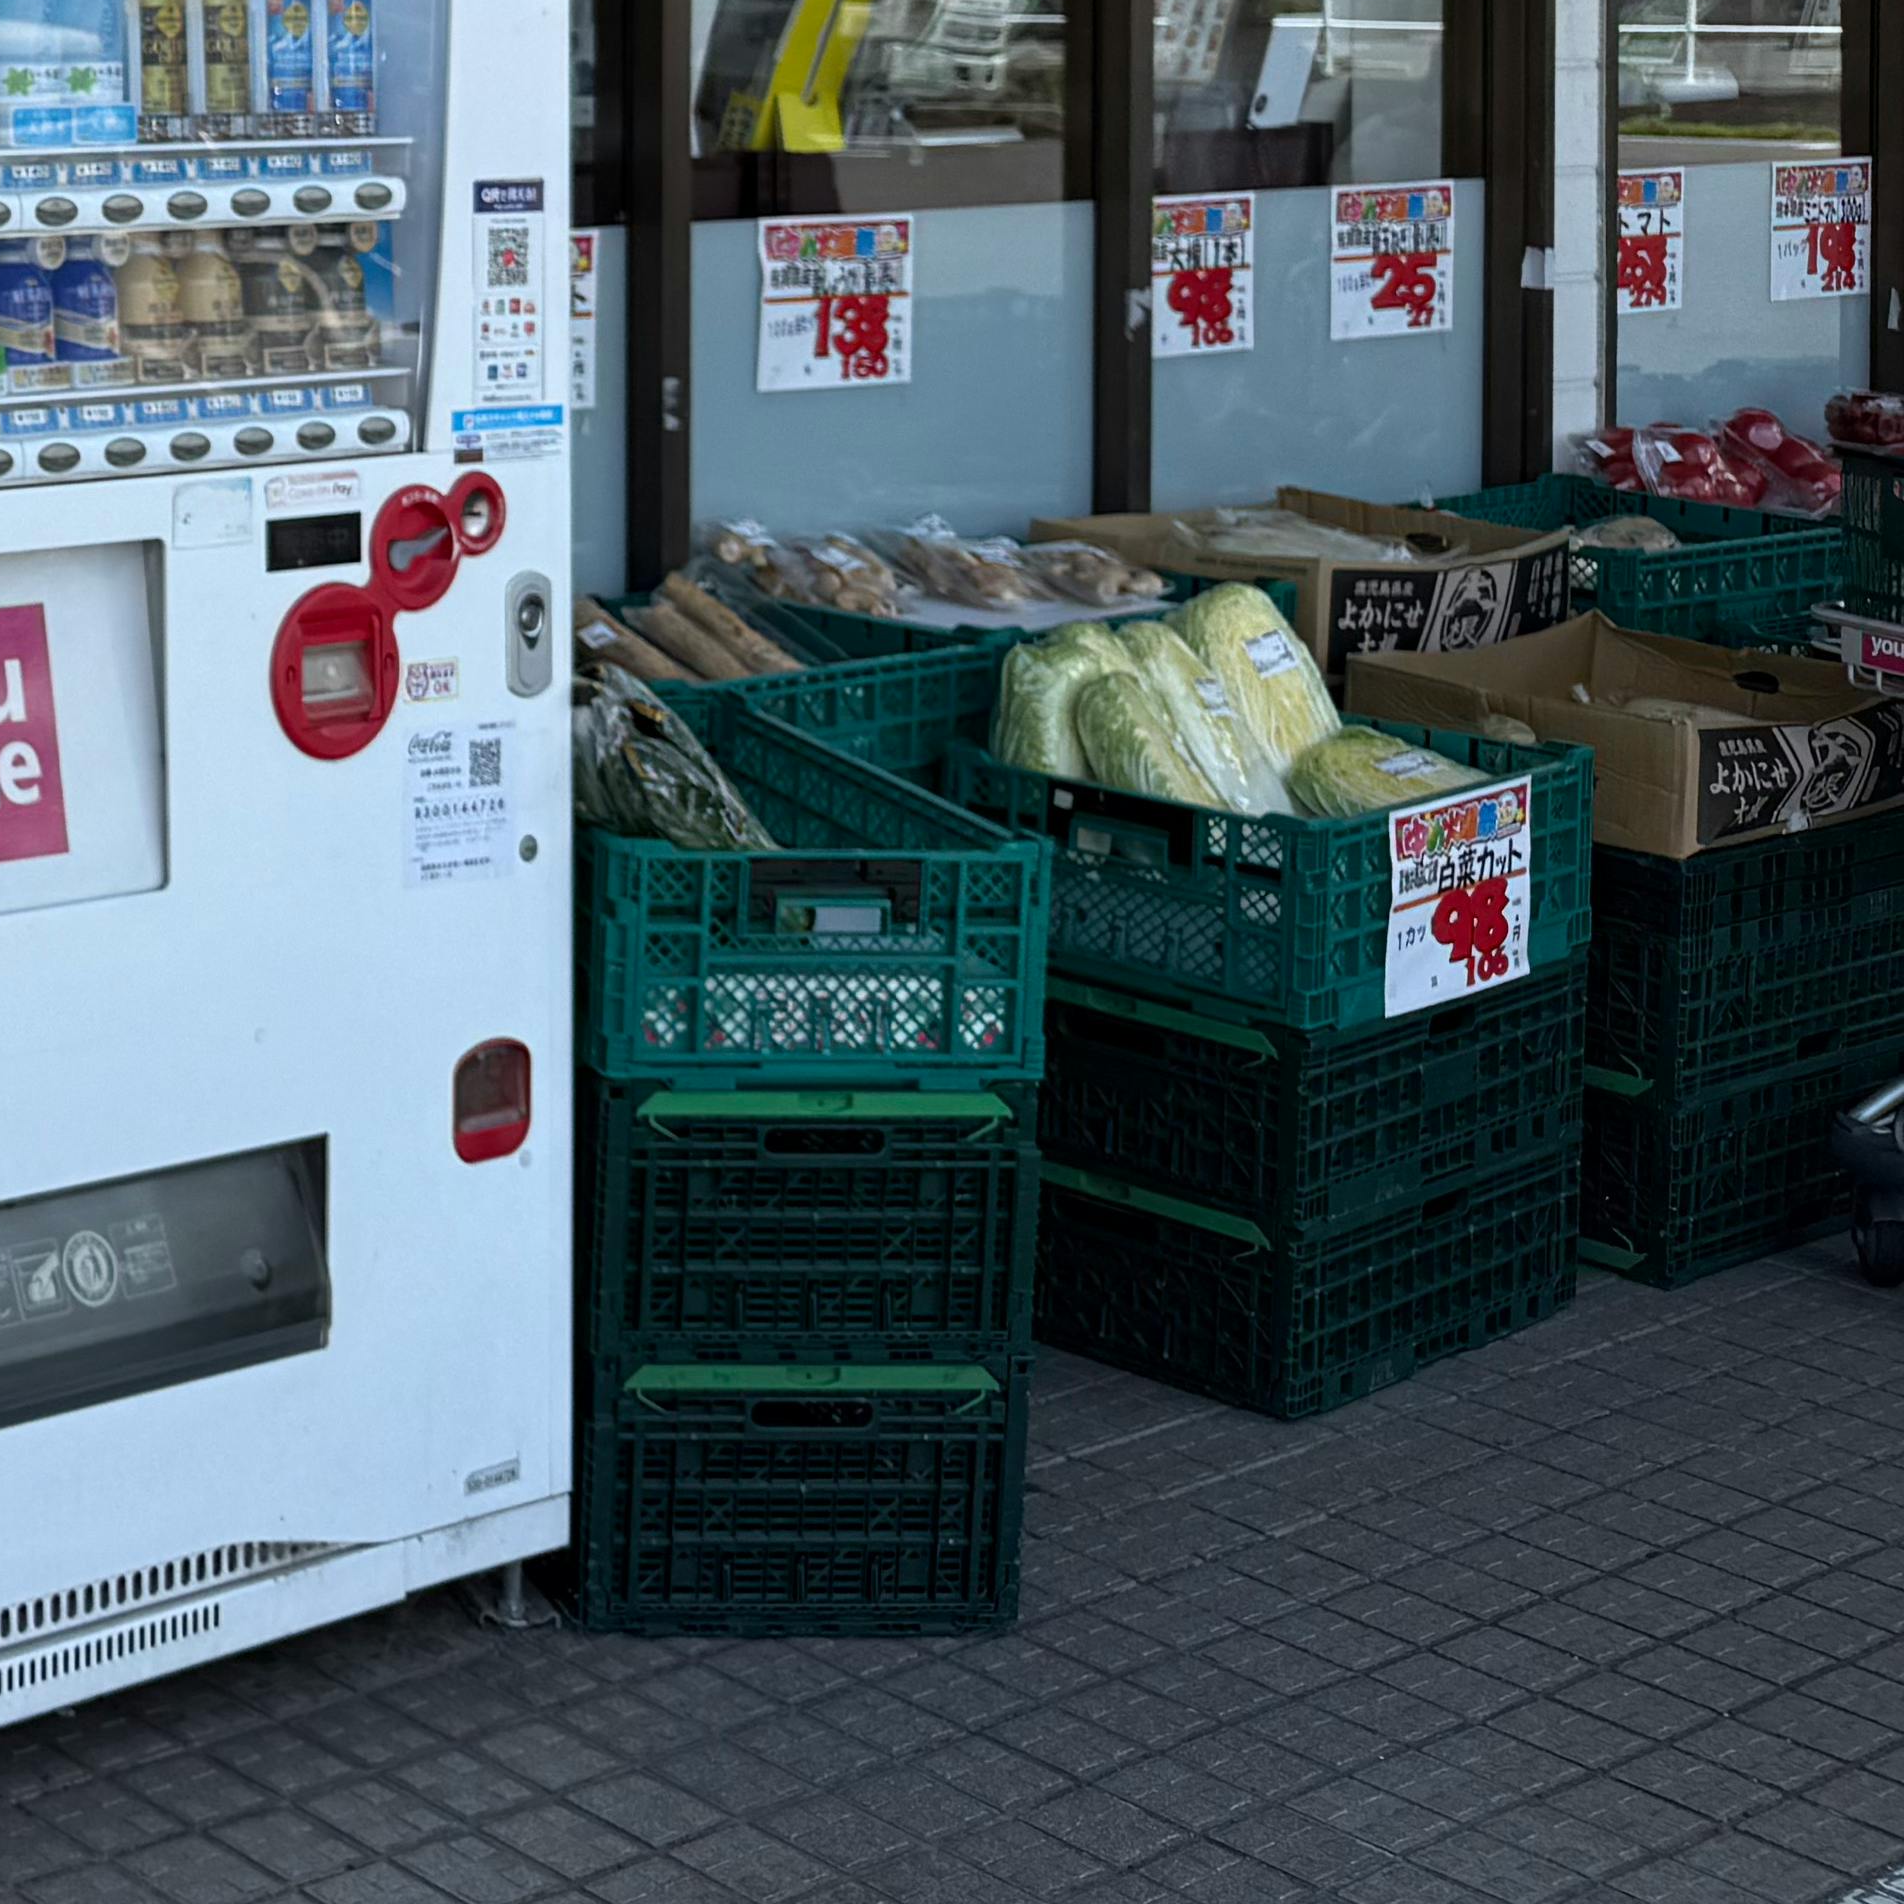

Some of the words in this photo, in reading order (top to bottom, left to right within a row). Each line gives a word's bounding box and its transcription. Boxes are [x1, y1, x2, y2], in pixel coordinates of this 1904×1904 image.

[1167, 269, 1233, 327] 98
[1370, 251, 1438, 312] 25
[1337, 597, 1424, 630] よかにせ
[1871, 635, 1904, 658] you
[1709, 756, 1790, 795] よかにせ
[1438, 838, 1523, 896] 白菜カット
[1431, 876, 1510, 964] 98
[1464, 945, 1510, 987] 106
